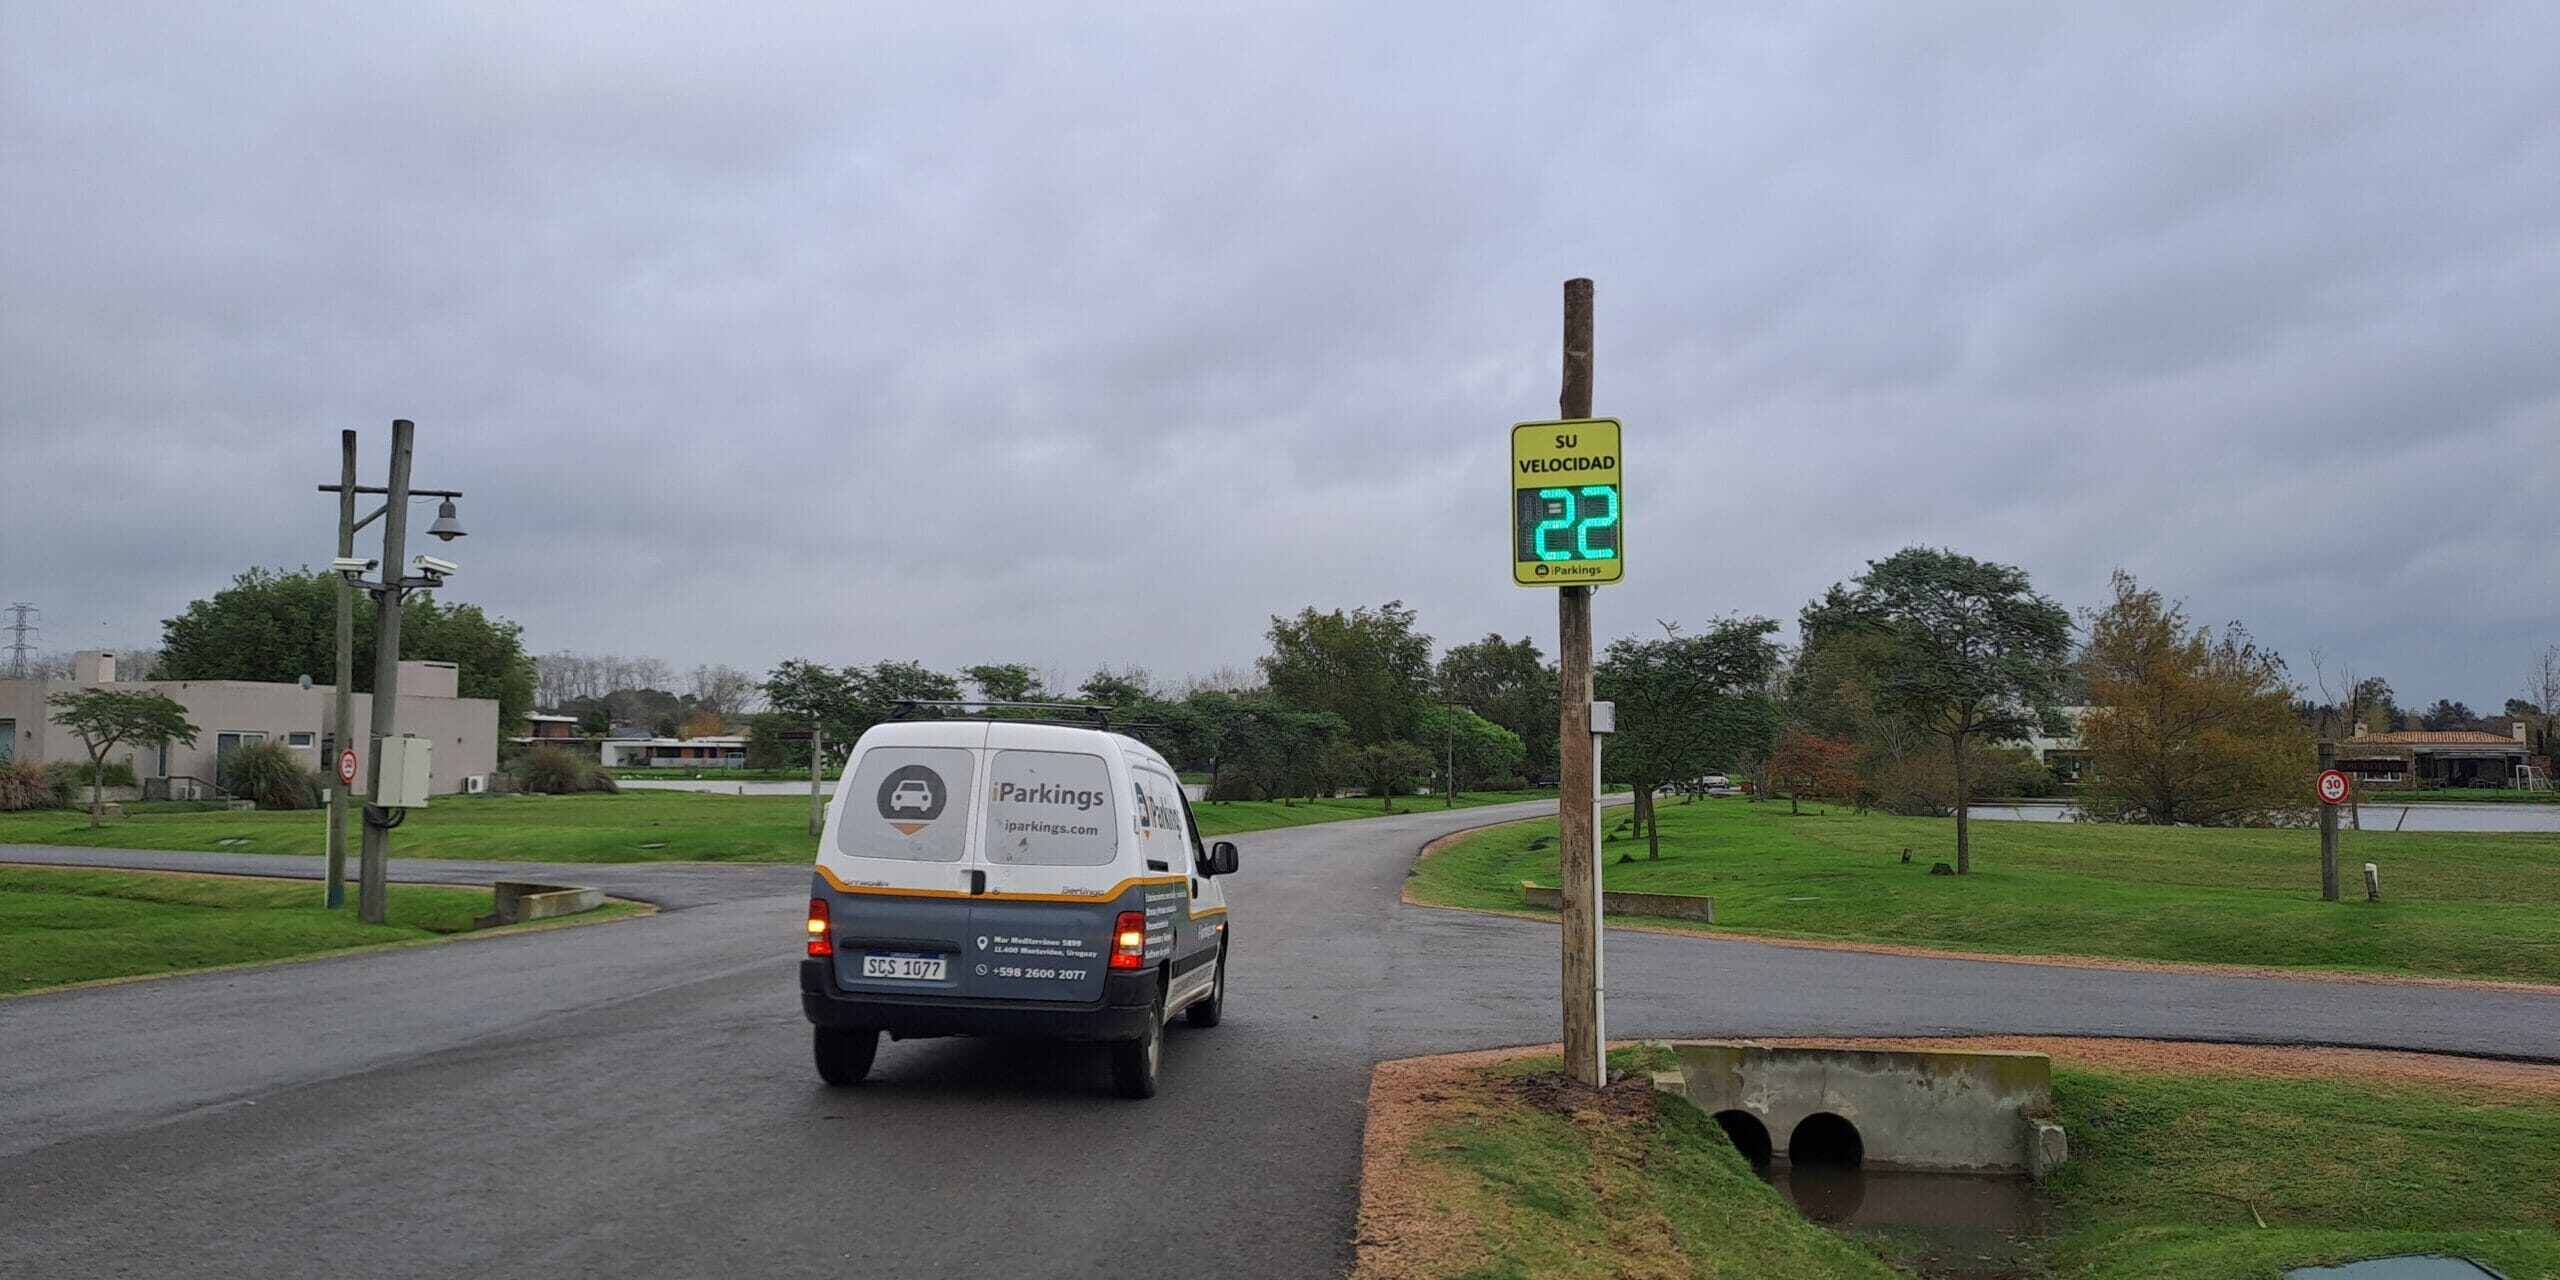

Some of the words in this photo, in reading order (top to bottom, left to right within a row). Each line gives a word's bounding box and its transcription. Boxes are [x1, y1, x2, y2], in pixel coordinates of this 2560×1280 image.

[1555, 434, 1578, 449] SU
[1519, 455, 1615, 474] VELOCIDAD
[1535, 486, 1618, 561] 22
[1551, 565, 1601, 576] iParkings
[2325, 780, 2341, 790] 30
[991, 781, 1104, 811] iParkings
[1004, 819, 1098, 836] iparkings.com
[993, 935, 1009, 944] Mar
[1066, 949, 1098, 959] Uruguay
[868, 958, 896, 975] SCS
[903, 960, 941, 979] 1077
[992, 966, 1021, 977] +598
[1025, 968, 1055, 978] 2600
[1058, 970, 1087, 980] 2077
